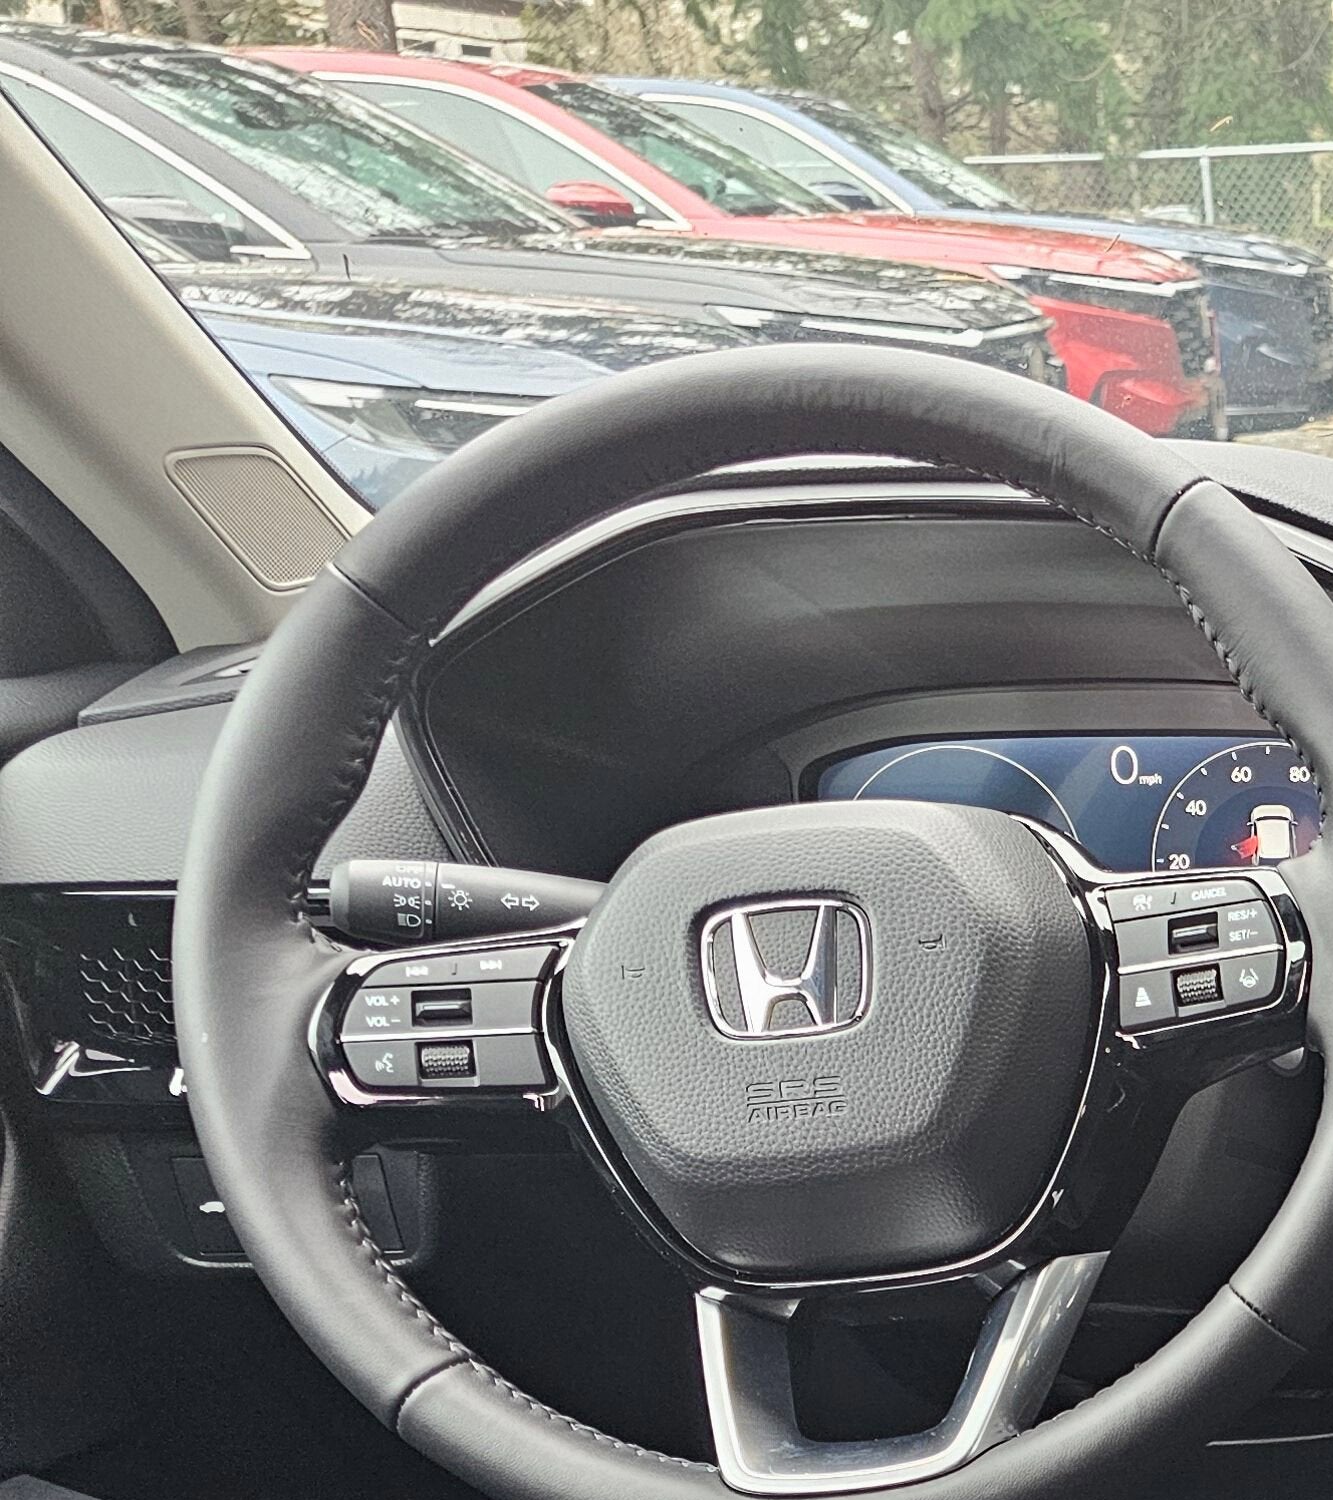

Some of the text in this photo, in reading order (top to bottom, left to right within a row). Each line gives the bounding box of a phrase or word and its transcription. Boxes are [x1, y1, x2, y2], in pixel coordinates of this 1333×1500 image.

[1110, 745, 1162, 788] 0 mph
[1230, 766, 1251, 783] 60
[1289, 766, 1310, 784] 80
[1185, 800, 1207, 817] 40
[1169, 854, 1190, 871] 20
[382, 876, 421, 889] AUTO
[1191, 888, 1227, 900] CANCEL
[1228, 909, 1257, 922] RES/+
[365, 996, 390, 1006] VOL
[365, 1017, 390, 1027] VOL
[746, 1076, 841, 1101] SRS
[748, 1101, 847, 1123] AIRBAG
